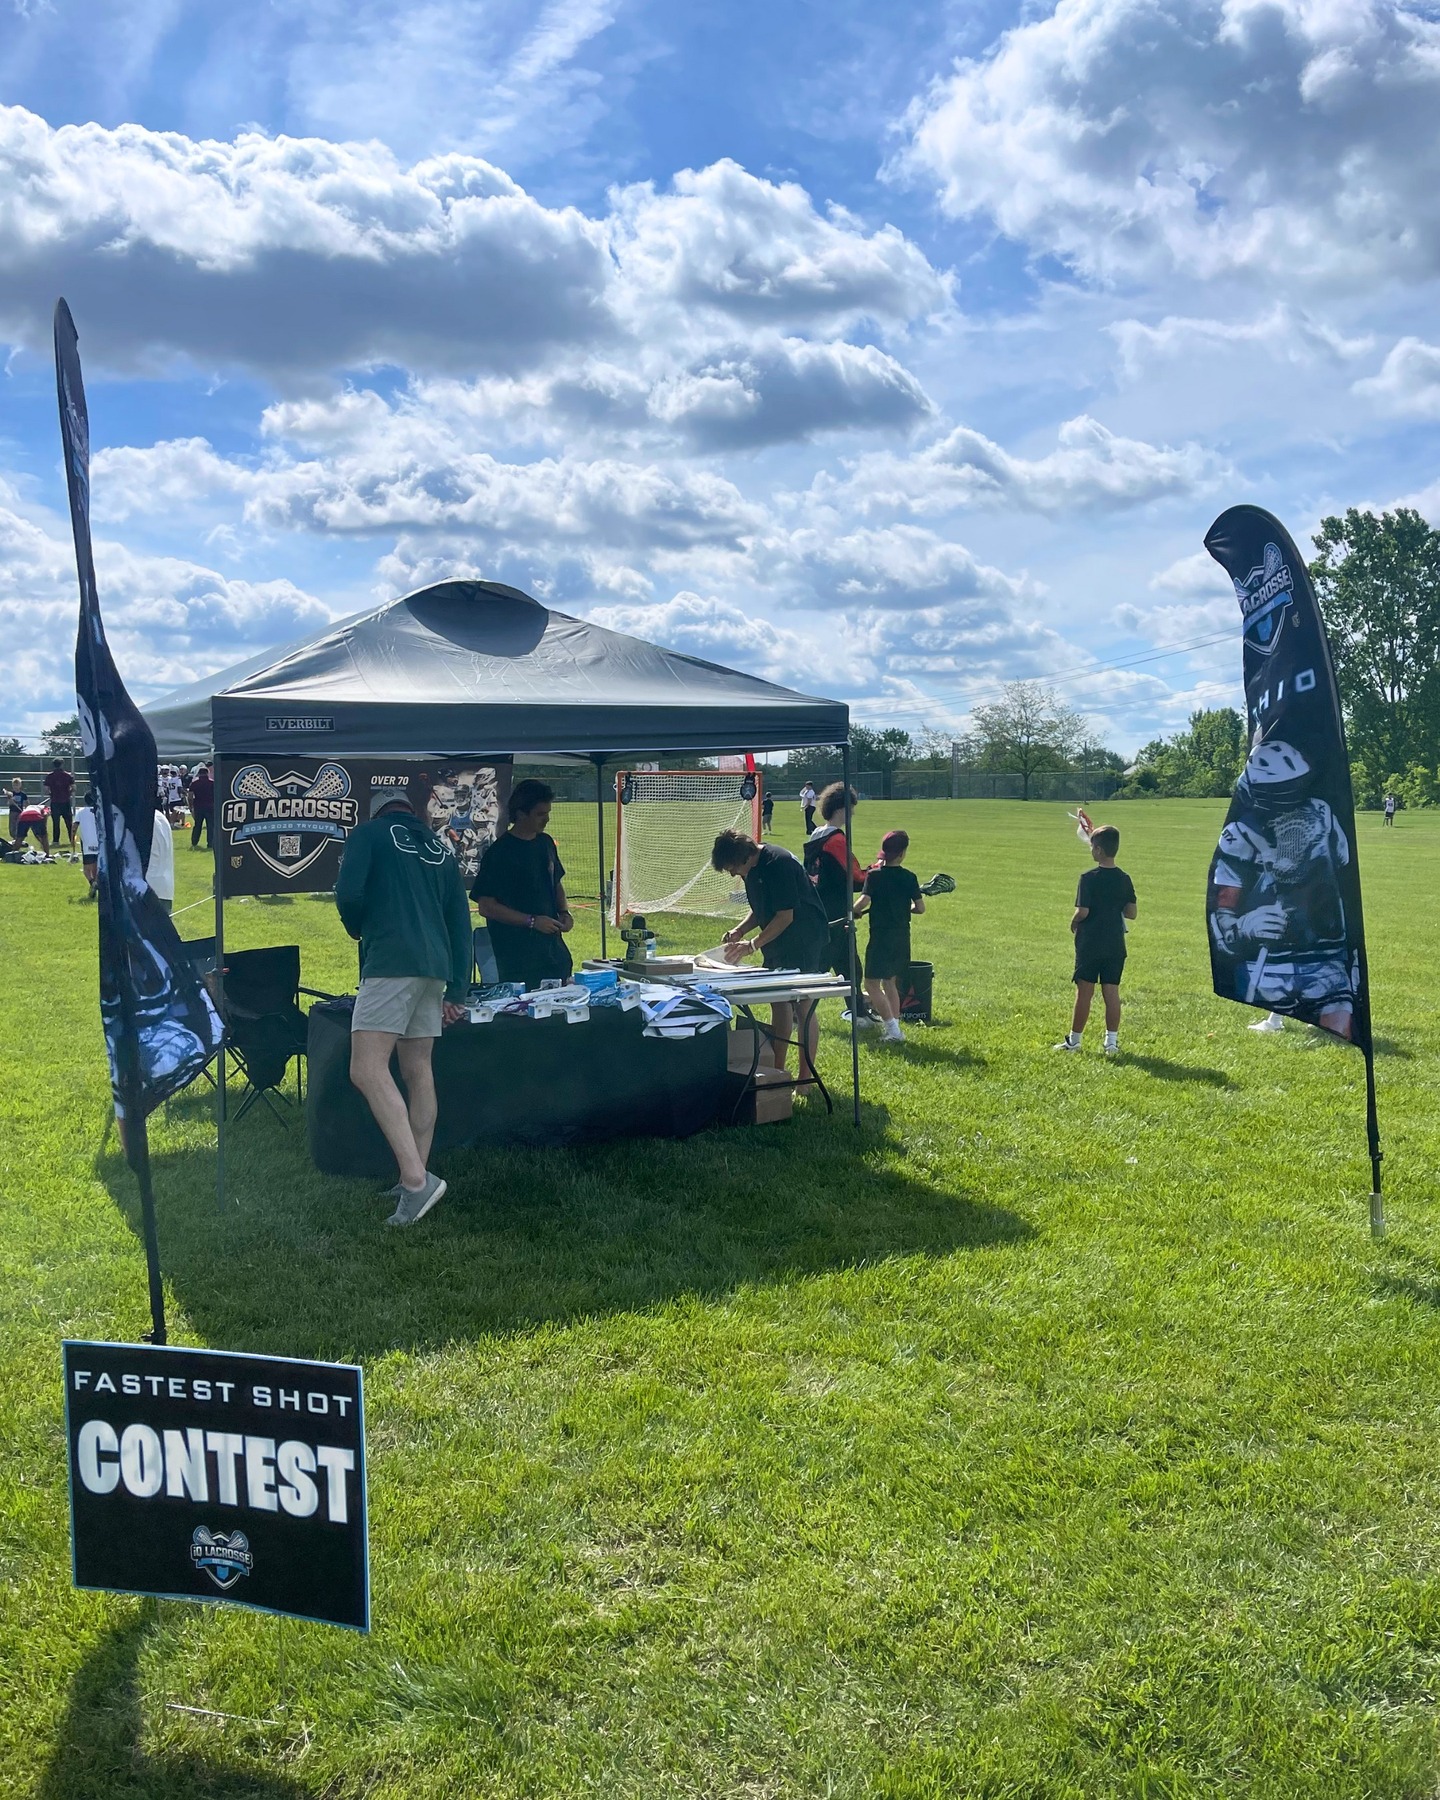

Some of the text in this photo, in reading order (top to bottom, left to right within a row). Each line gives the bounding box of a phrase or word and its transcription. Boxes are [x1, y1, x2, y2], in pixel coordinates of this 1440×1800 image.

[1243, 569, 1291, 617] ACROSSE
[268, 718, 332, 729] EVERBILT
[371, 775, 409, 786] OVER 70
[227, 798, 353, 823] iQ LACROSSE
[296, 823, 335, 831] TRYOUTS
[74, 1371, 352, 1417] FASTEST SHOT
[78, 1420, 355, 1524] CONTEST
[205, 1546, 251, 1564] LACROSSE
